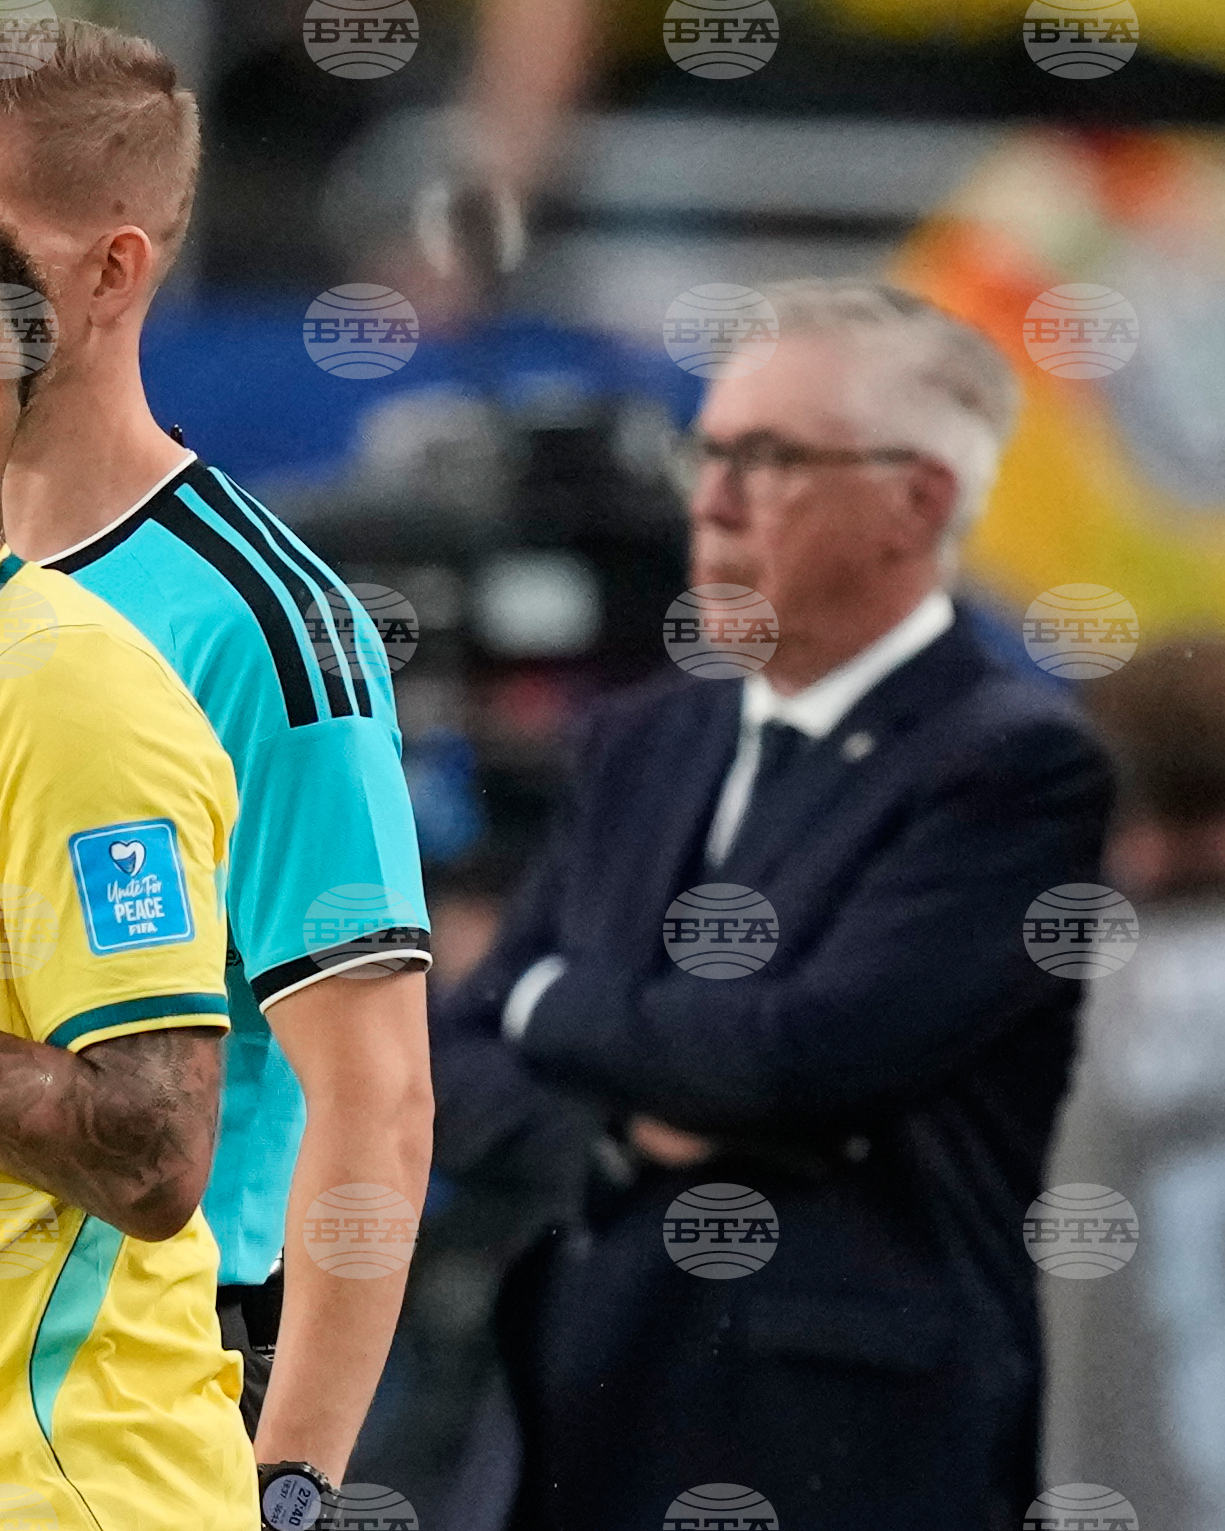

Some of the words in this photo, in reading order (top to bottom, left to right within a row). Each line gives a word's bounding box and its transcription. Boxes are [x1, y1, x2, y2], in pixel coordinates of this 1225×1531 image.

[141, 874, 163, 897] For
[114, 897, 166, 924] PEACE
[128, 921, 158, 937] FIFA
[289, 1488, 311, 1526] 27:40
